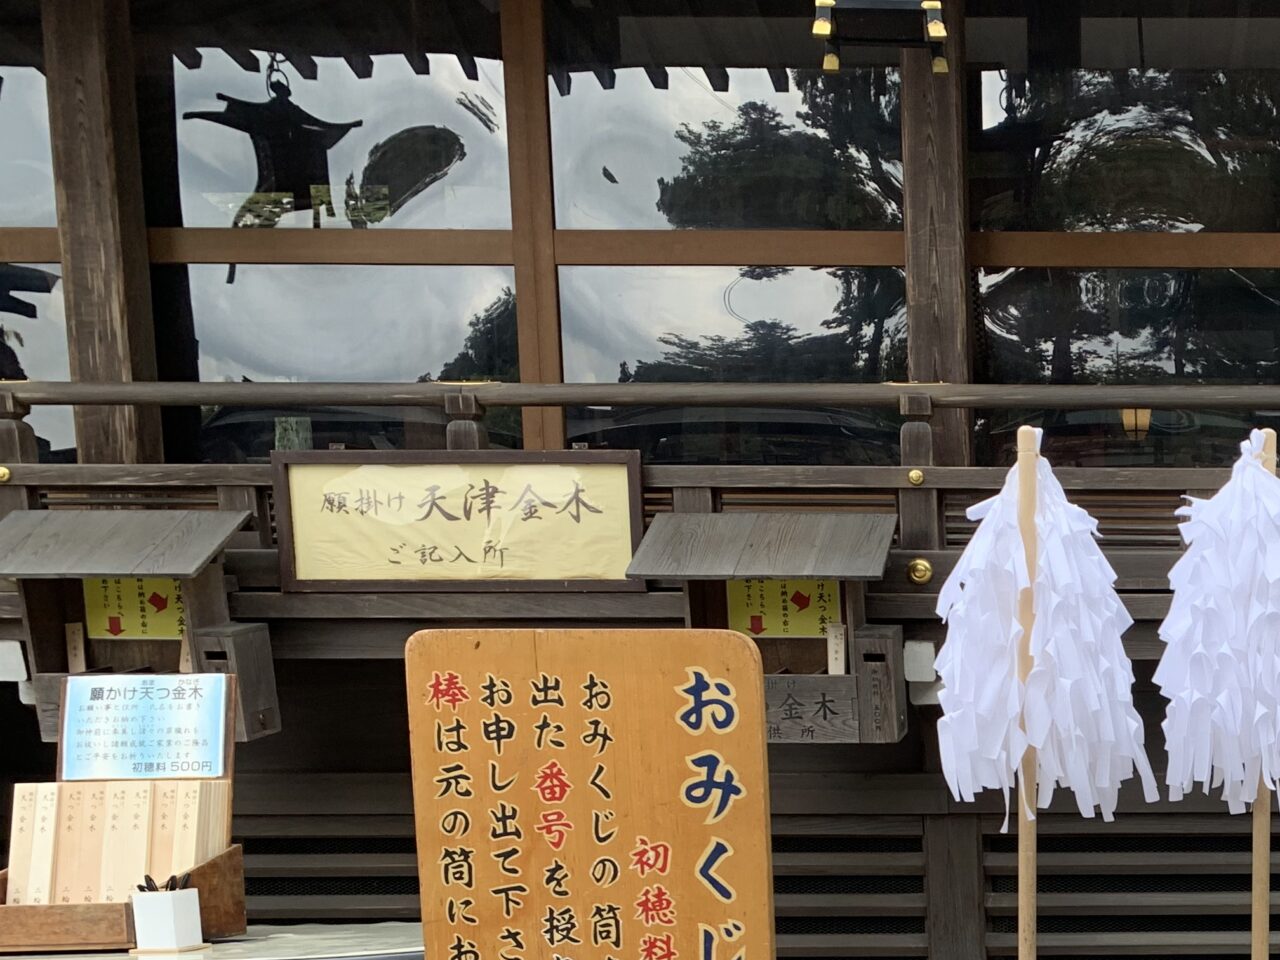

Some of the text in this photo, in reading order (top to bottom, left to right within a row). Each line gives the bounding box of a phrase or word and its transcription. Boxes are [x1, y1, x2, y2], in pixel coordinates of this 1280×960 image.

[321, 479, 604, 524] 願掛け 天津金木
[387, 541, 510, 568] ご記入所
[173, 578, 186, 636] け天つ金木
[816, 579, 828, 636] け天つ金木
[89, 686, 204, 701] 願かけ天つ金木
[765, 693, 840, 720] 金木
[132, 761, 212, 773] 初穂料 500円
